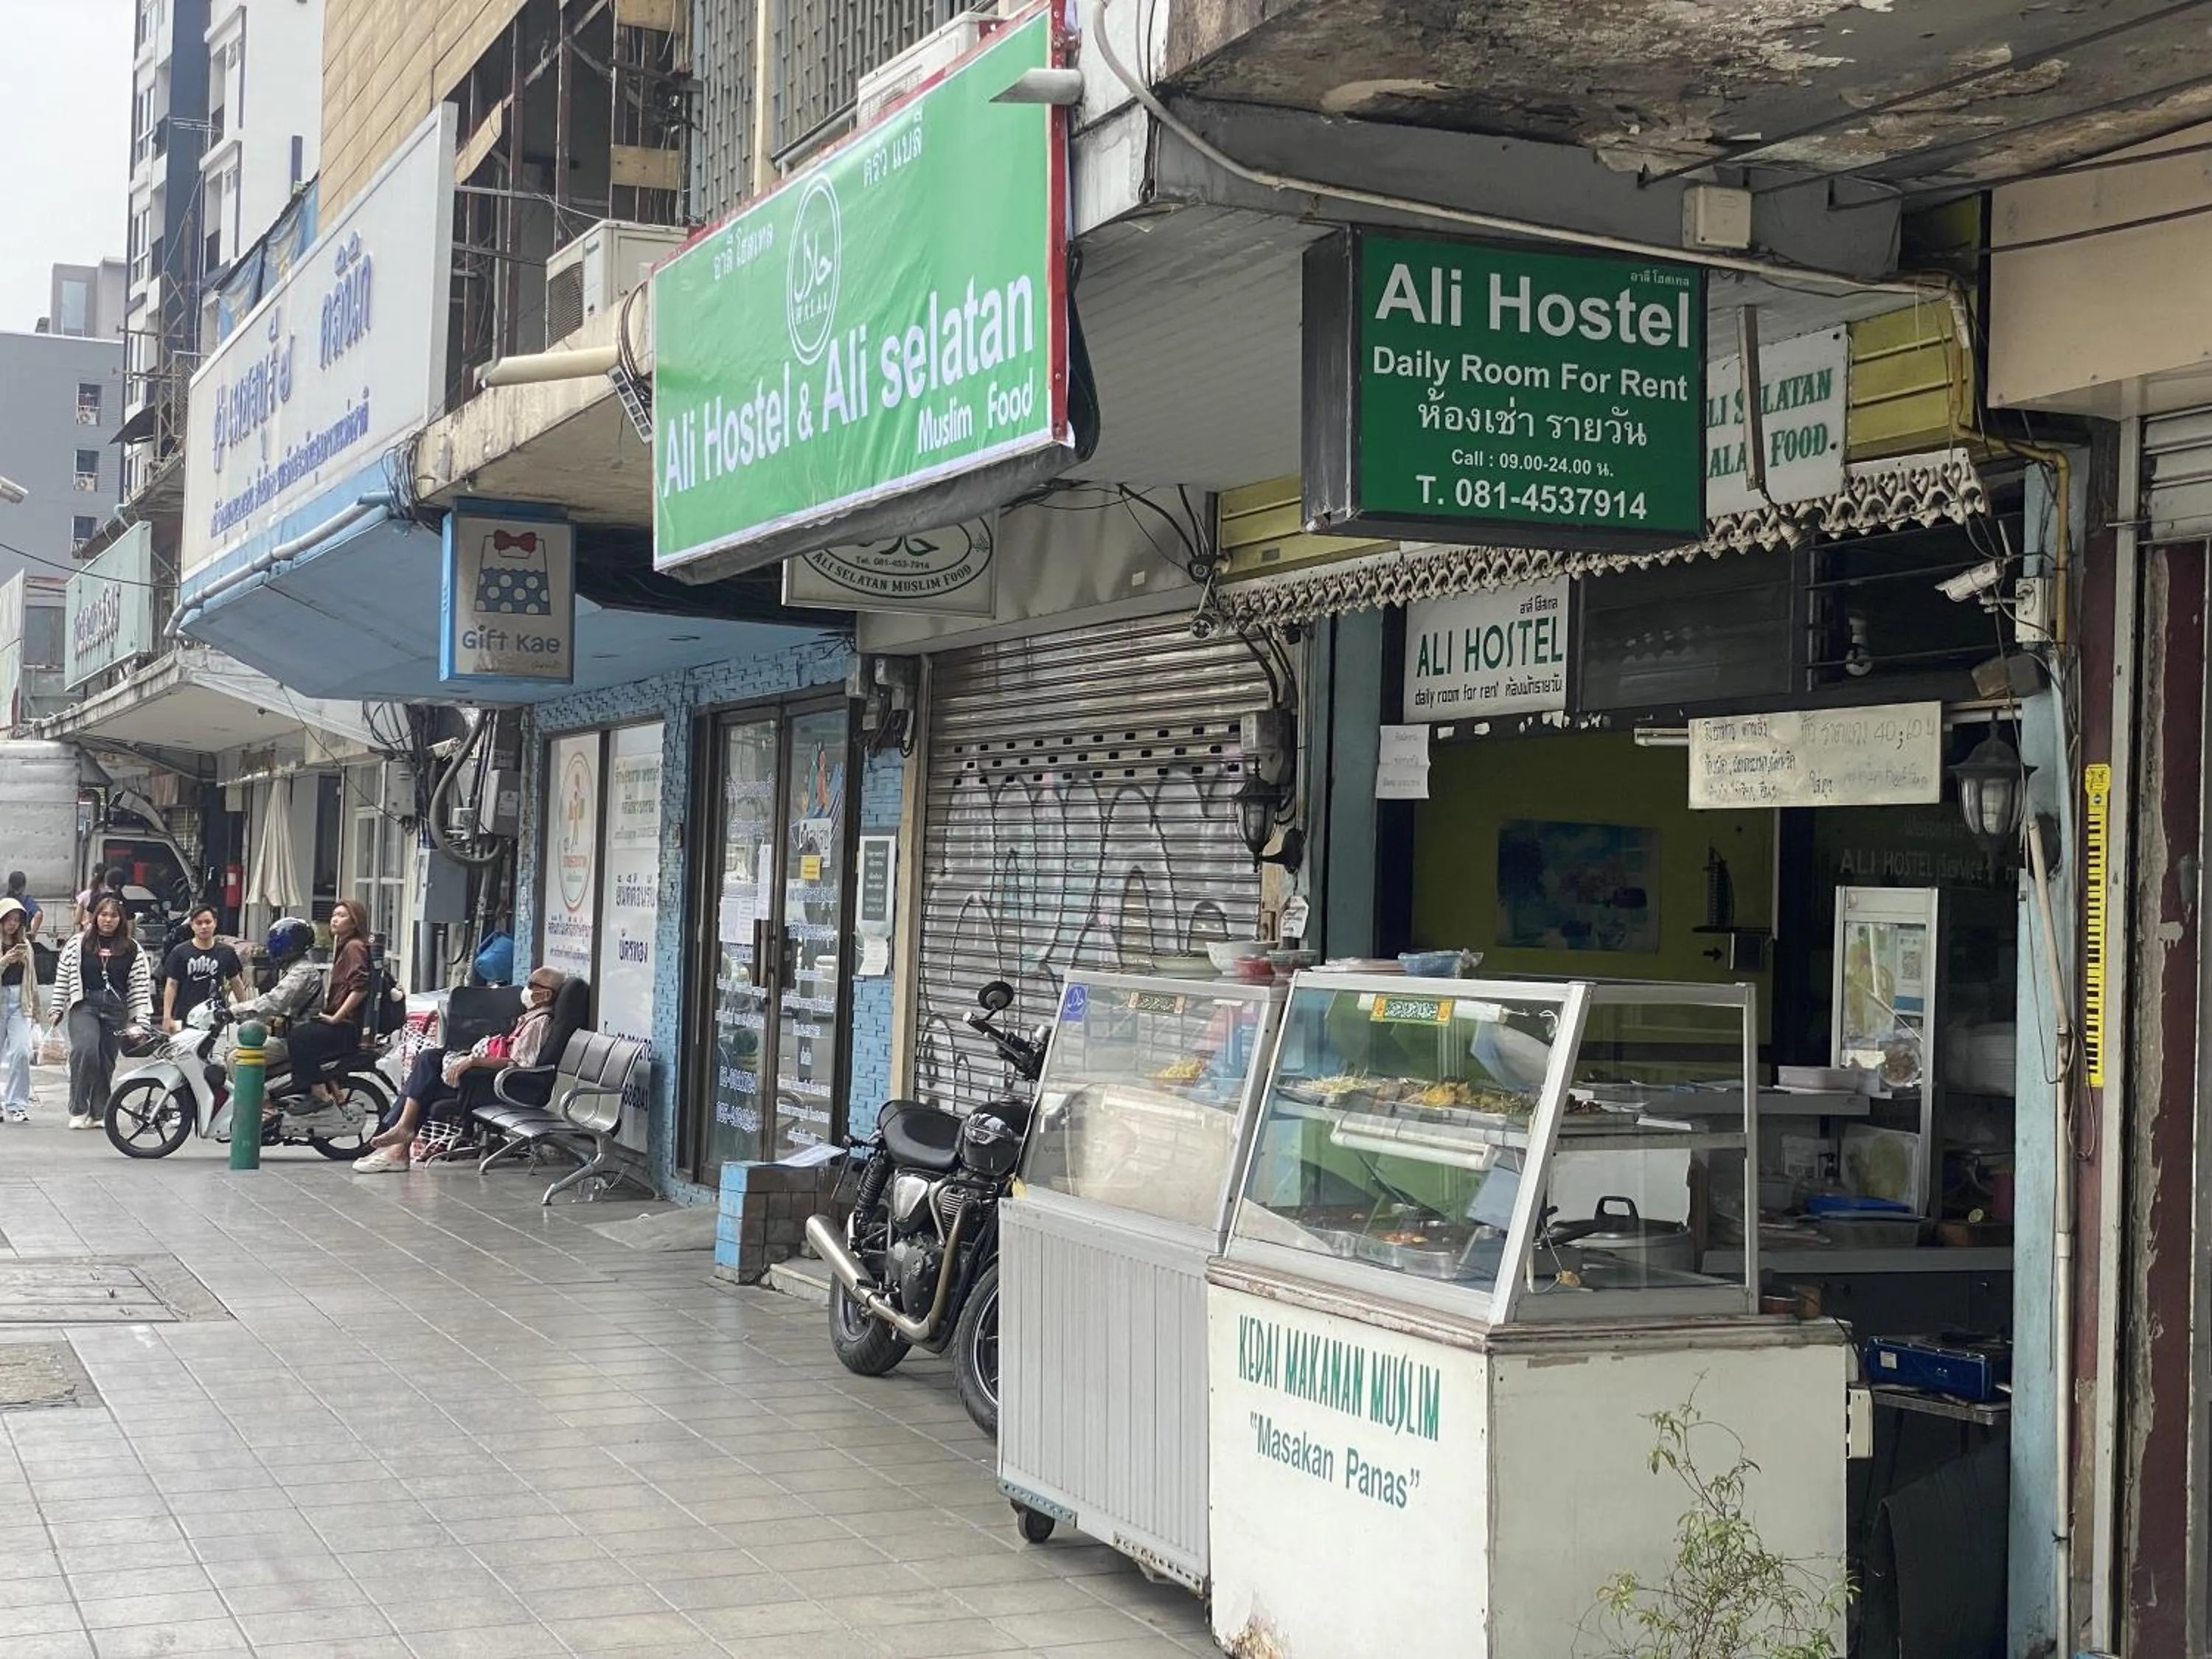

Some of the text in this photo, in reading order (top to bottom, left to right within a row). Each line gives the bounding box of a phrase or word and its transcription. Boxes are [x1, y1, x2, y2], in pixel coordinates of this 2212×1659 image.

[1374, 263, 1689, 349] Ali Hostel
[664, 274, 1033, 498] Ali Hostel & Ali selatan
[1373, 346, 1688, 401] Daily Room For Rent
[1706, 369, 1833, 428] LI SLATAN
[918, 369, 1032, 454] Muslim Food
[1417, 386, 1646, 447] ห้องเช่า รายวัน
[1451, 448, 1484, 467] Call
[1499, 453, 1591, 476] 09.00-24.00
[1416, 475, 1647, 521] T. 081-4537914
[812, 552, 973, 592] ALI SELATAN MUSLIM FOOD
[462, 625, 560, 653] Gift Kae
[1416, 616, 1563, 678] ALI HOSTEL
[1415, 687, 1435, 709] daily
[1437, 689, 1459, 703] room
[1463, 684, 1477, 700] for
[1840, 849, 1875, 874] ALI
[1882, 849, 1933, 876] HOSTEL
[1239, 1314, 1440, 1441] KEDAI MAKANAN MUSLIM
